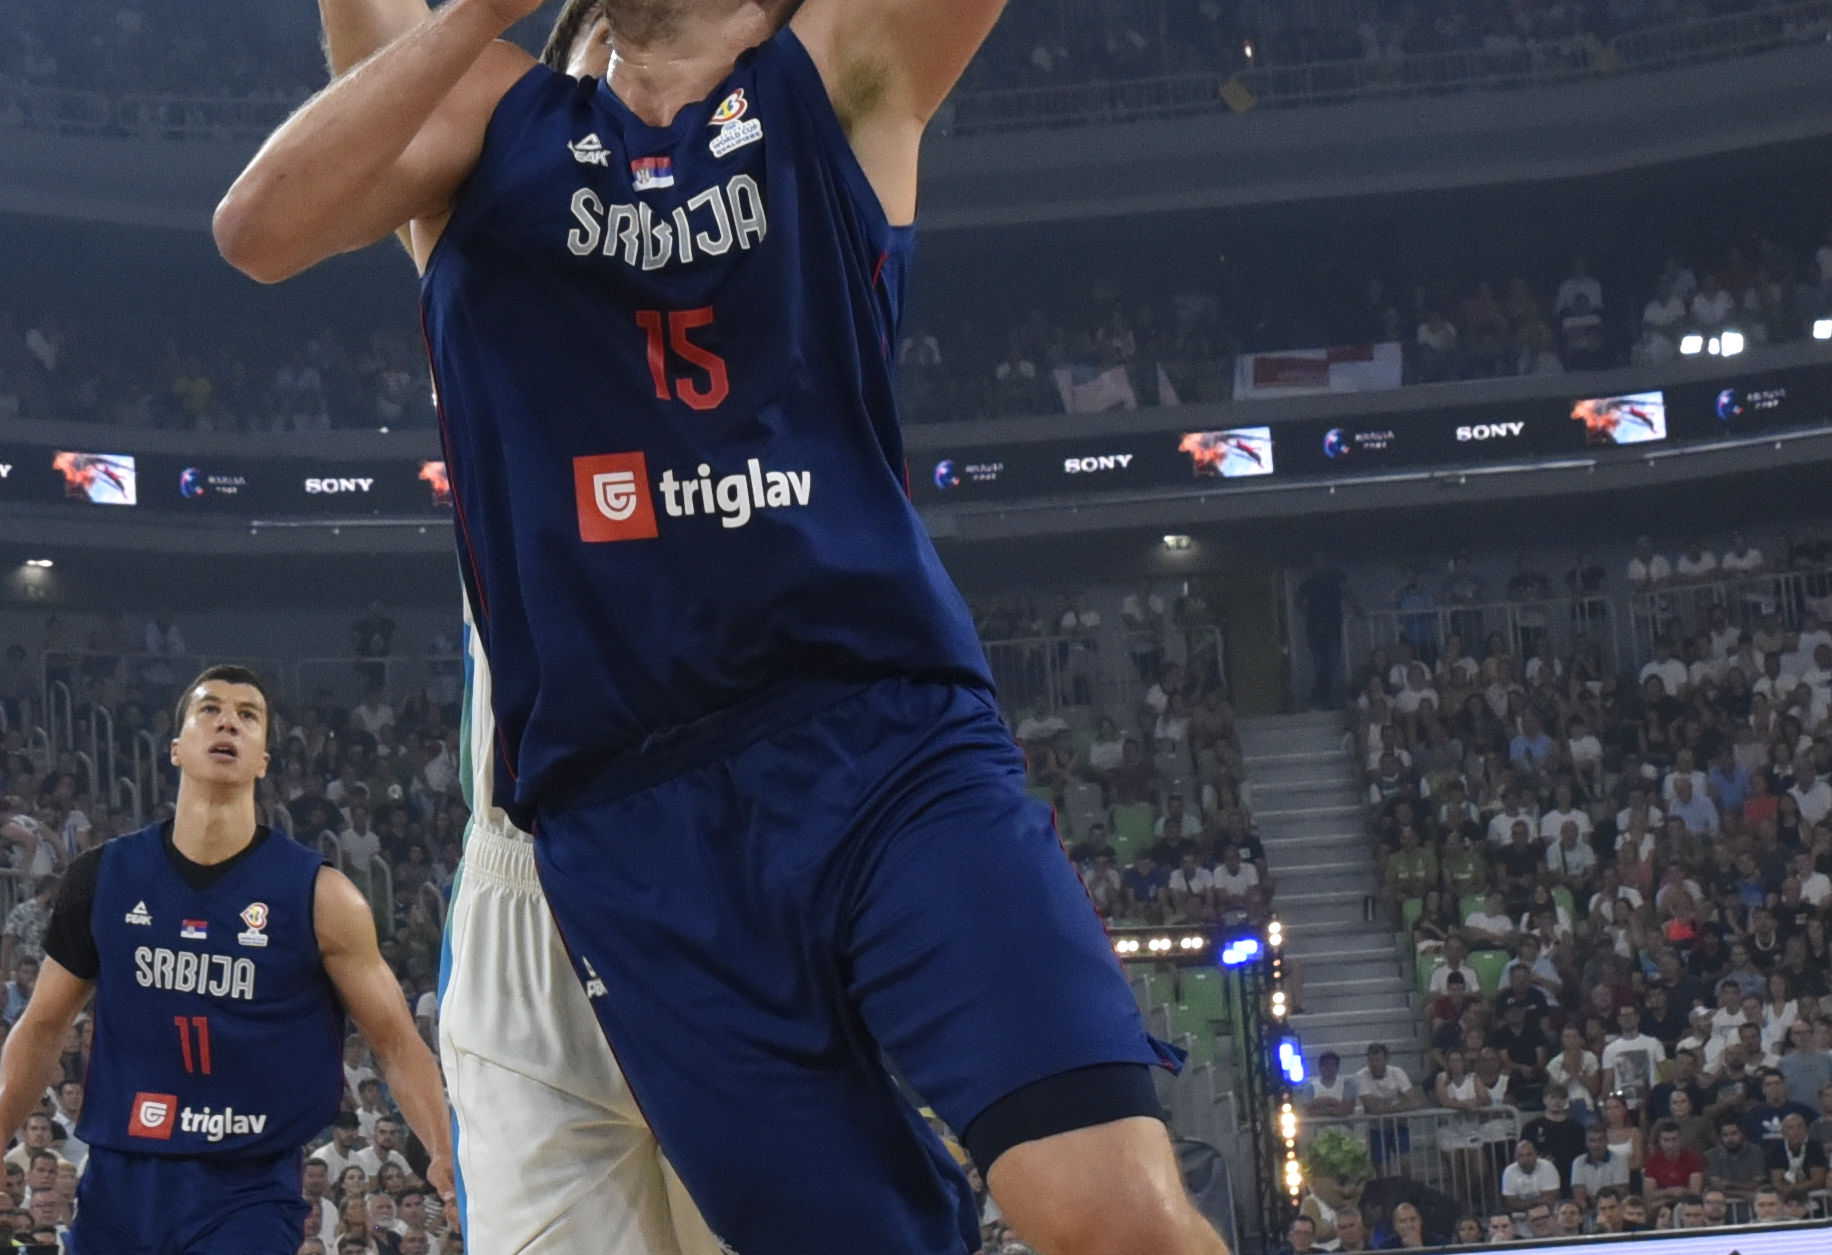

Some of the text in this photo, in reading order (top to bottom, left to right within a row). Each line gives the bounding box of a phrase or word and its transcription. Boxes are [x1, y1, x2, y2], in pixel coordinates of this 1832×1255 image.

[567, 174, 767, 271] SRBIJA
[636, 306, 729, 412] 15
[1456, 421, 1525, 442] SONY
[305, 478, 374, 494] SONY
[1064, 454, 1134, 474] SONY
[659, 458, 811, 529] triglav
[135, 946, 256, 1000] SRBIJA
[174, 1015, 212, 1075] 11
[181, 1106, 267, 1142] triglav
